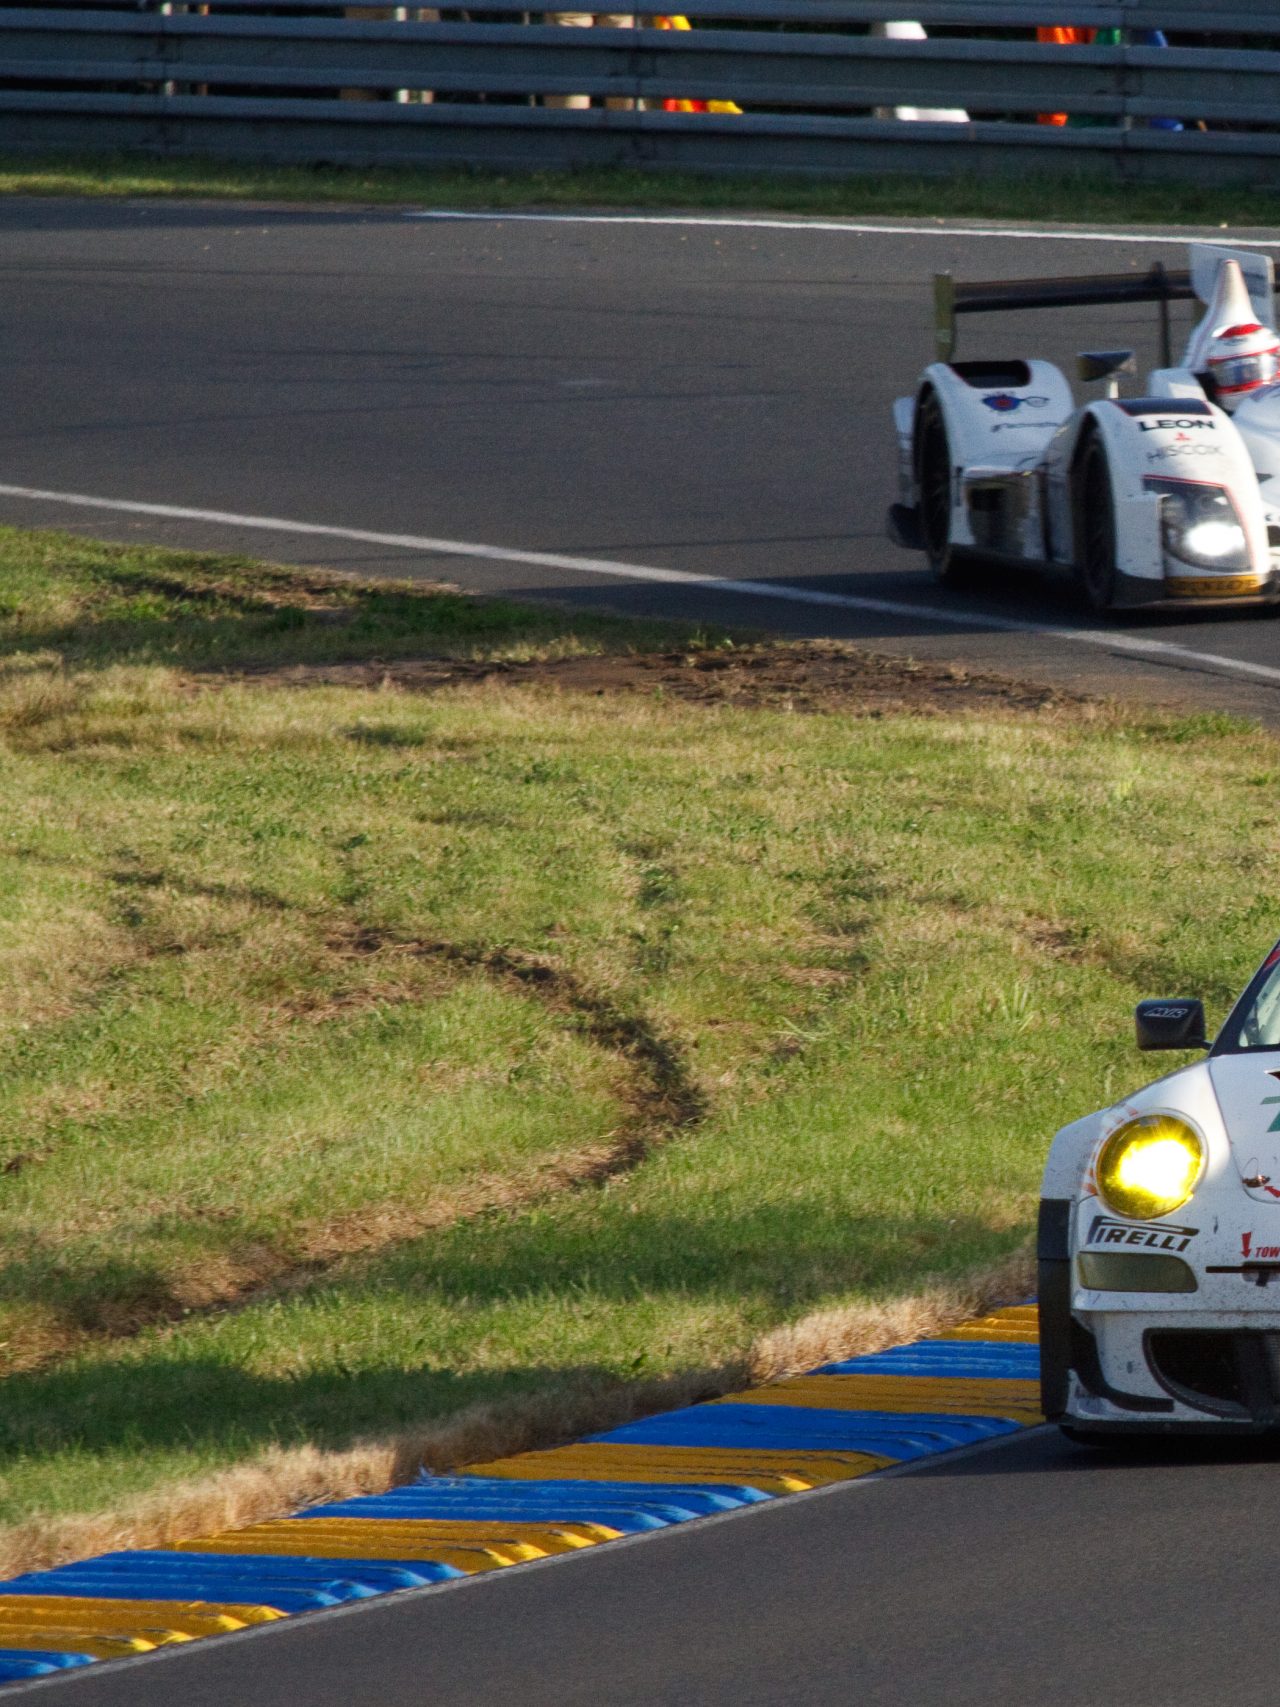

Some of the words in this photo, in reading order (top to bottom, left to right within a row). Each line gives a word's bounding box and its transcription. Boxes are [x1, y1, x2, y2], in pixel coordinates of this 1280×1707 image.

[1138, 419, 1215, 432] LEON
[1086, 1215, 1199, 1252] PIRELLI
[1255, 1246, 1280, 1258] TOW
